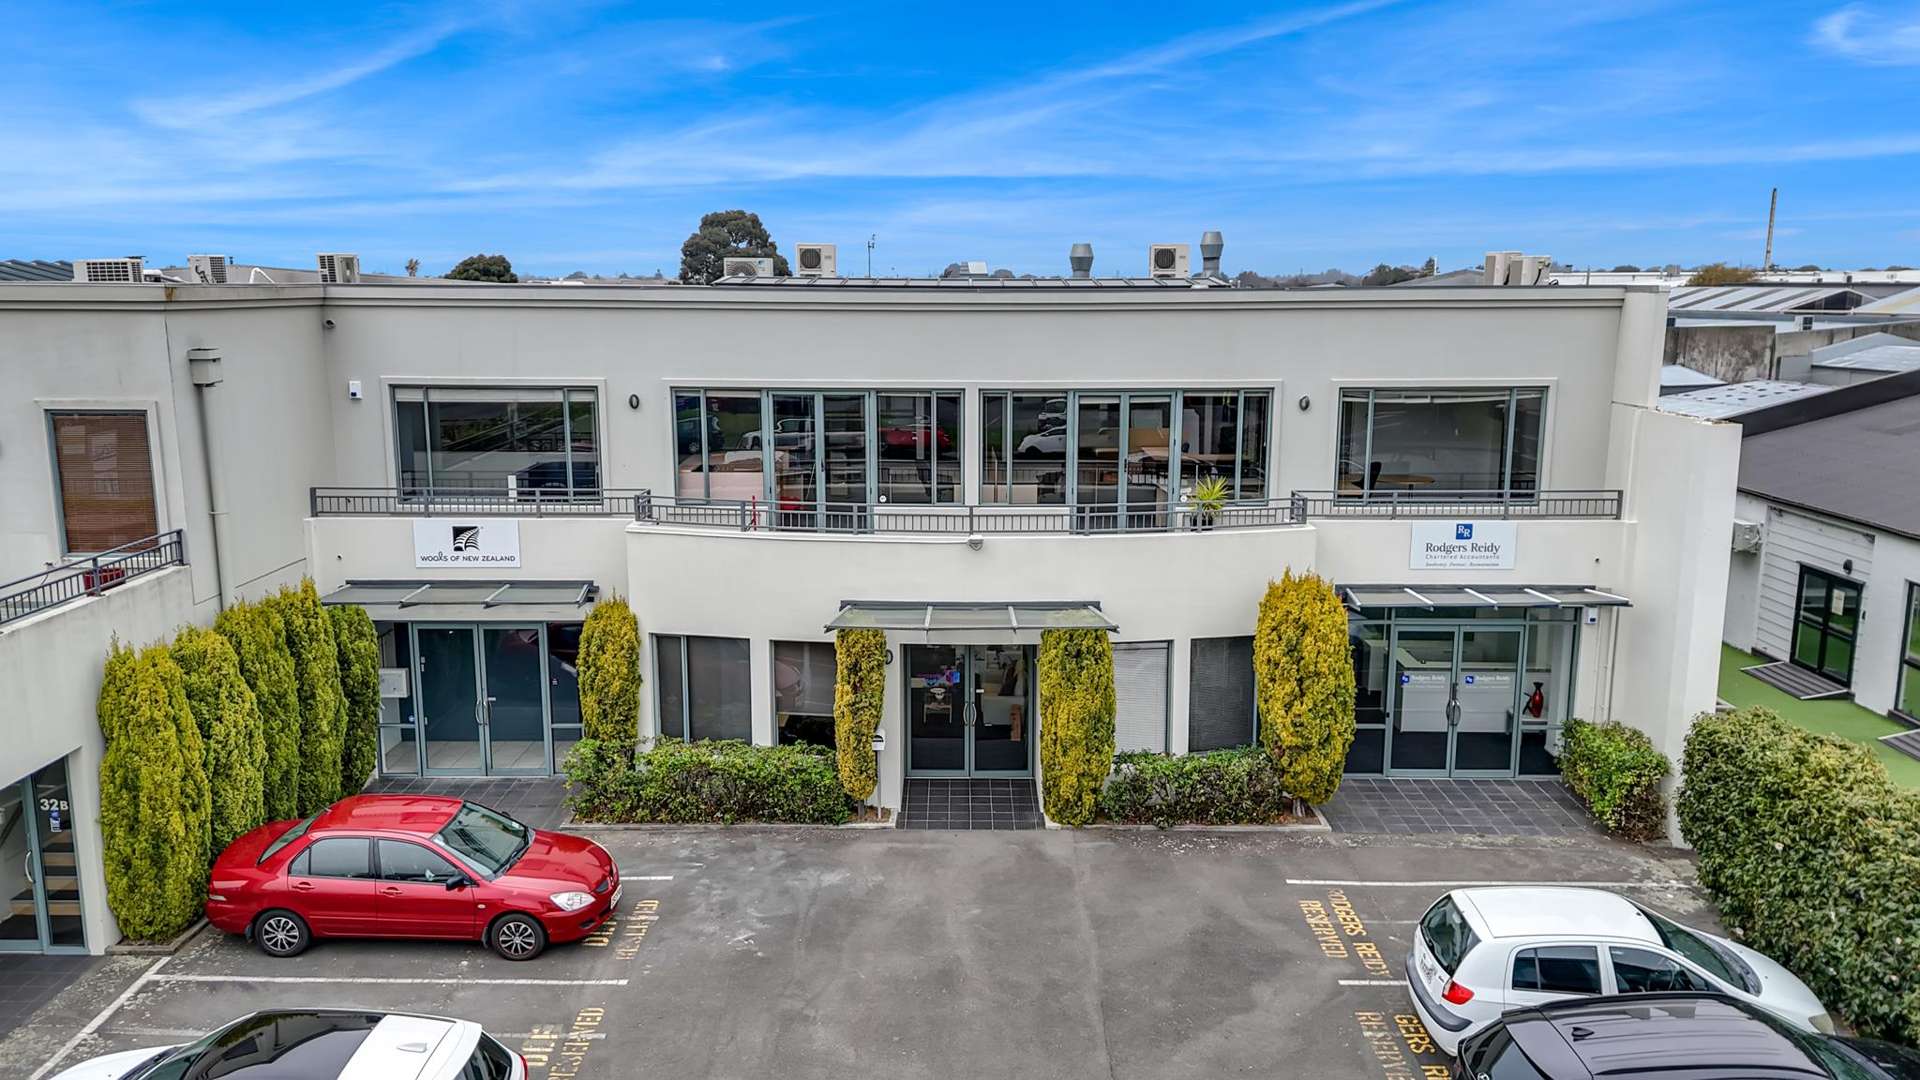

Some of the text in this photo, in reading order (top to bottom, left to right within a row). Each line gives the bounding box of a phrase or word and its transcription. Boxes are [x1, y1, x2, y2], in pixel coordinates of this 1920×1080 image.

[1457, 525, 1471, 538] RR
[1425, 542, 1501, 555] Rodgers Reidy
[40, 798, 69, 811] 32B
[1298, 900, 1349, 958] RESERVED
[1327, 888, 1393, 978] RODGERS REIDY
